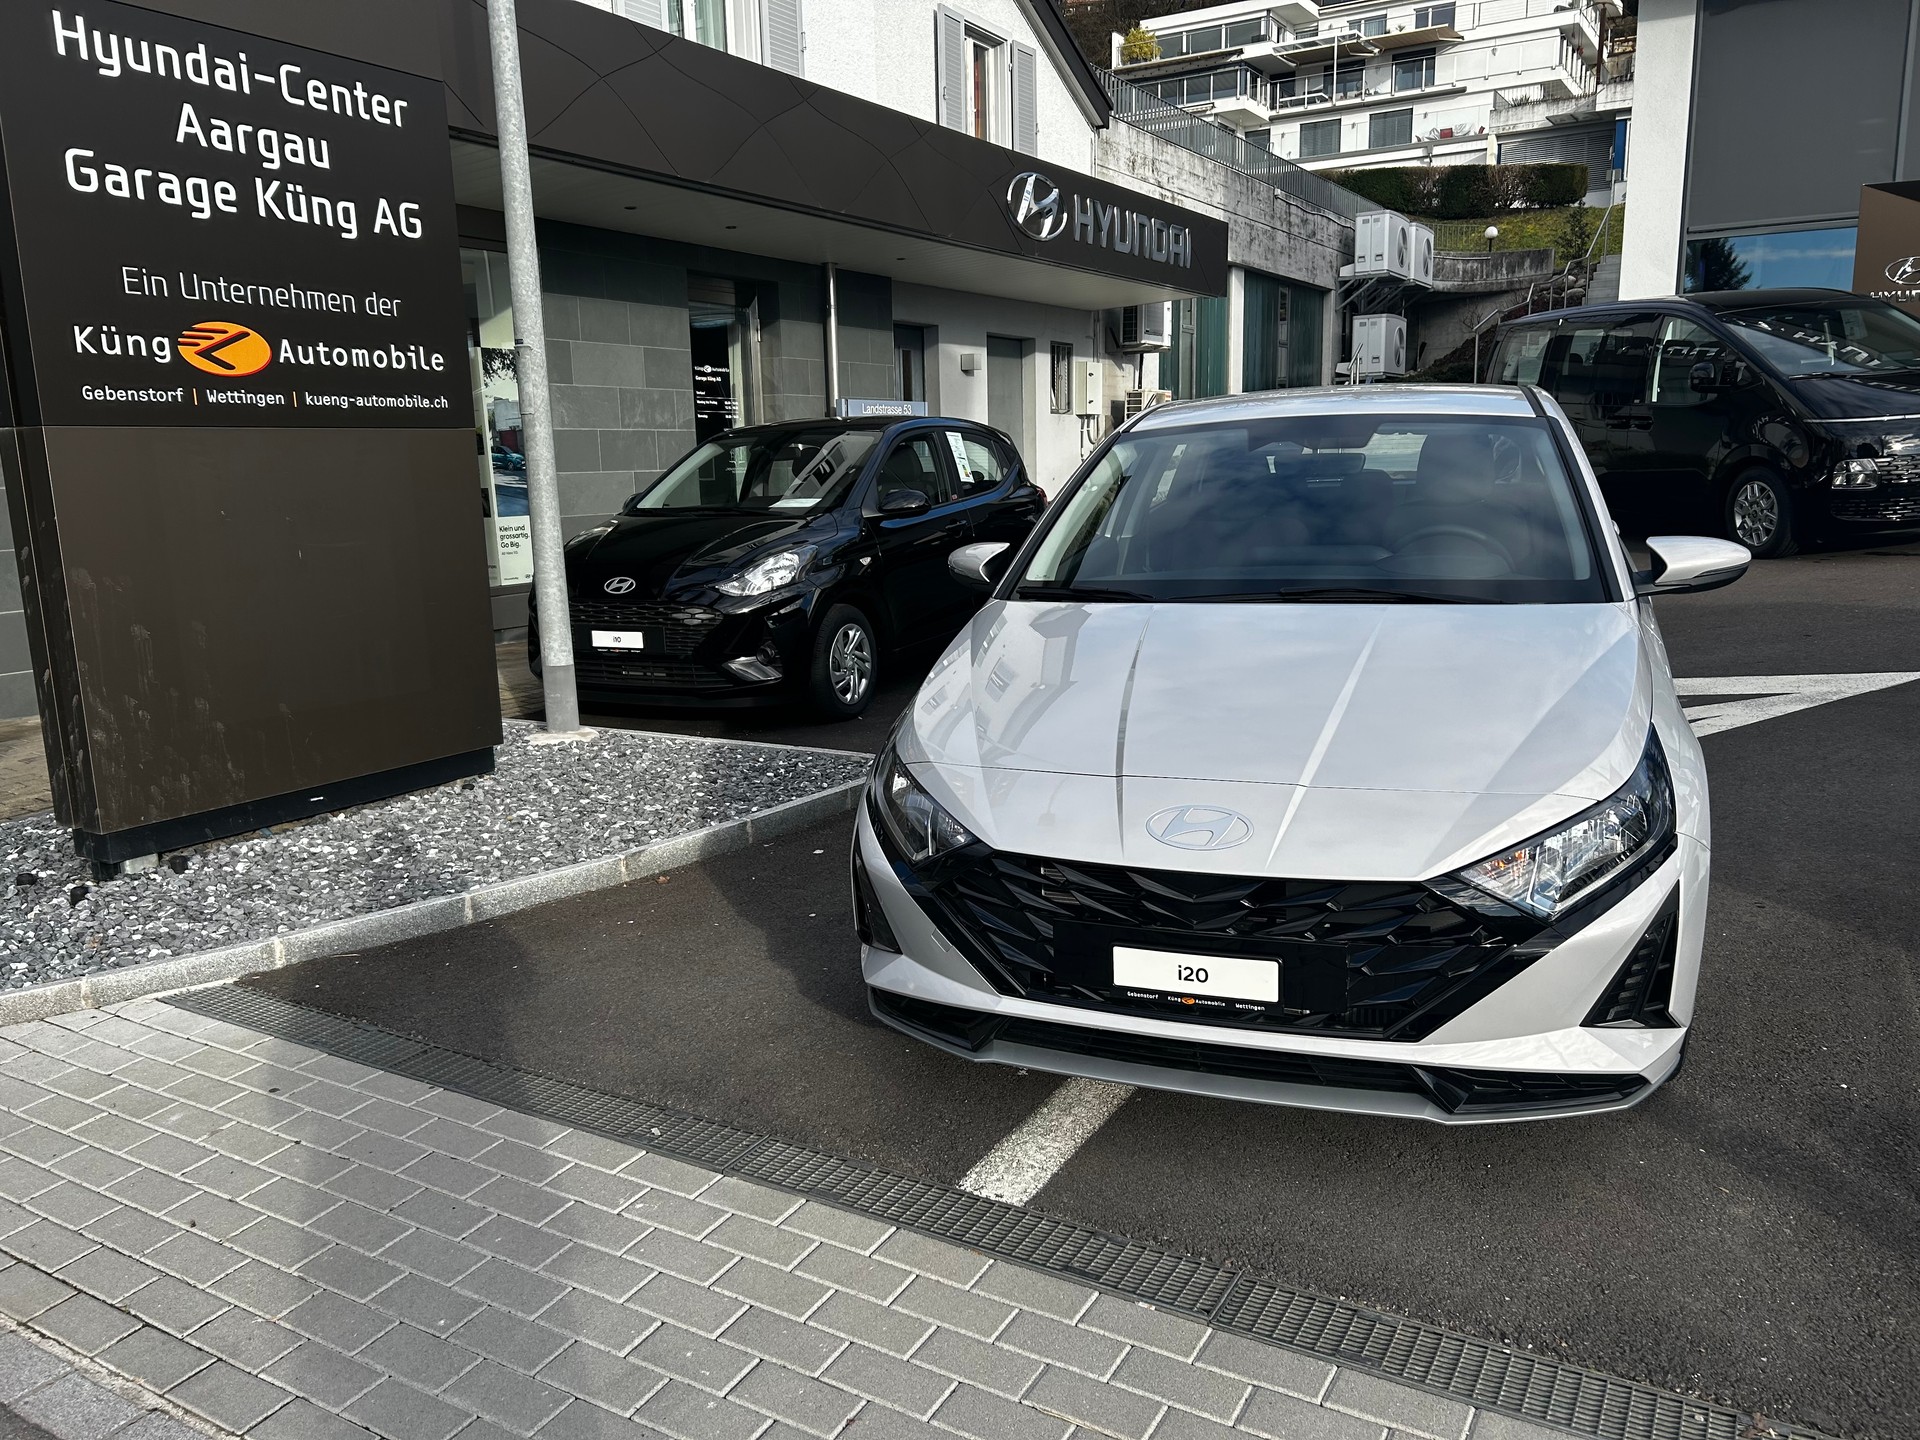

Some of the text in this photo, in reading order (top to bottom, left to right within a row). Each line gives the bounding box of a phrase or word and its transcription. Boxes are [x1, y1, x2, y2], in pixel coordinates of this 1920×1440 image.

[52, 10, 407, 127] Hyundai-Center
[176, 103, 330, 169] Aargau
[65, 148, 422, 239] Garage Küng AG
[1073, 194, 1191, 268] HYUNDAI
[122, 267, 402, 317] Ein Unternehmen der
[74, 326, 444, 371] Küng Automobile
[82, 386, 448, 408] Gebenstorf Wettingen kueng-automobile.ch
[862, 403, 912, 415] Landstrasse 53
[1178, 965, 1209, 983] i20
